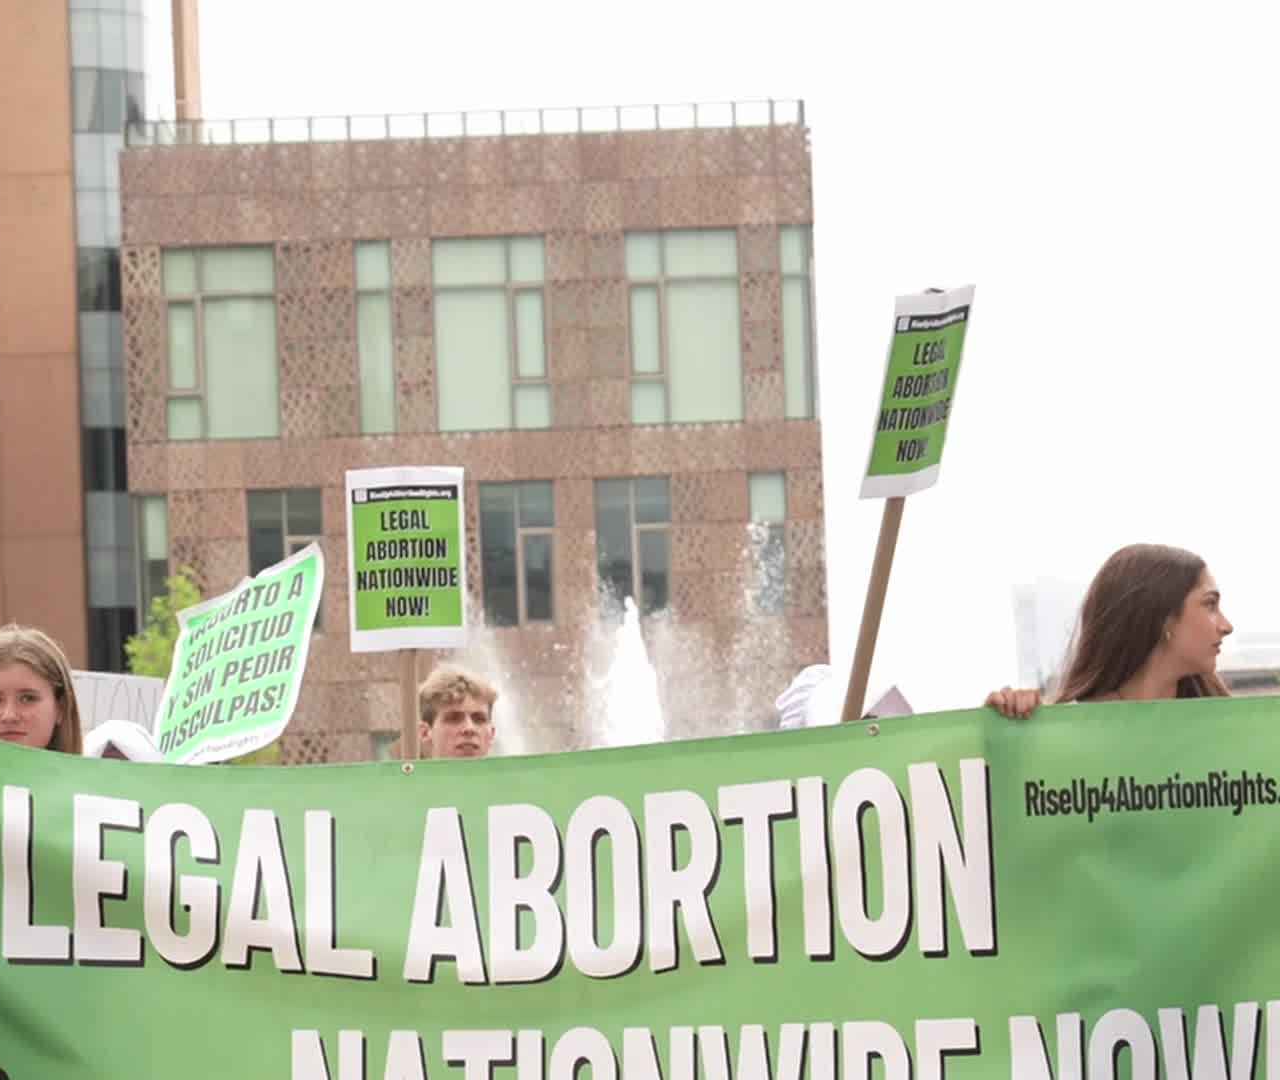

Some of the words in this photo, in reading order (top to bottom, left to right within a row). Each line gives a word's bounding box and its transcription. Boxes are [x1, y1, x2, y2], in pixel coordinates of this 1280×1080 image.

[380, 509, 431, 532] LEGAL
[365, 537, 448, 562] ABORTION
[287, 571, 304, 601] A
[356, 566, 458, 591] NATIONWIDE
[385, 595, 430, 618] NOW!
[182, 610, 295, 679] SOLICITUD
[182, 668, 216, 710] SIN
[220, 645, 295, 688] PEDIR
[159, 682, 287, 756] DISCULPAS!
[1, 784, 377, 981] LEGAL
[403, 757, 998, 987] ABORTION
